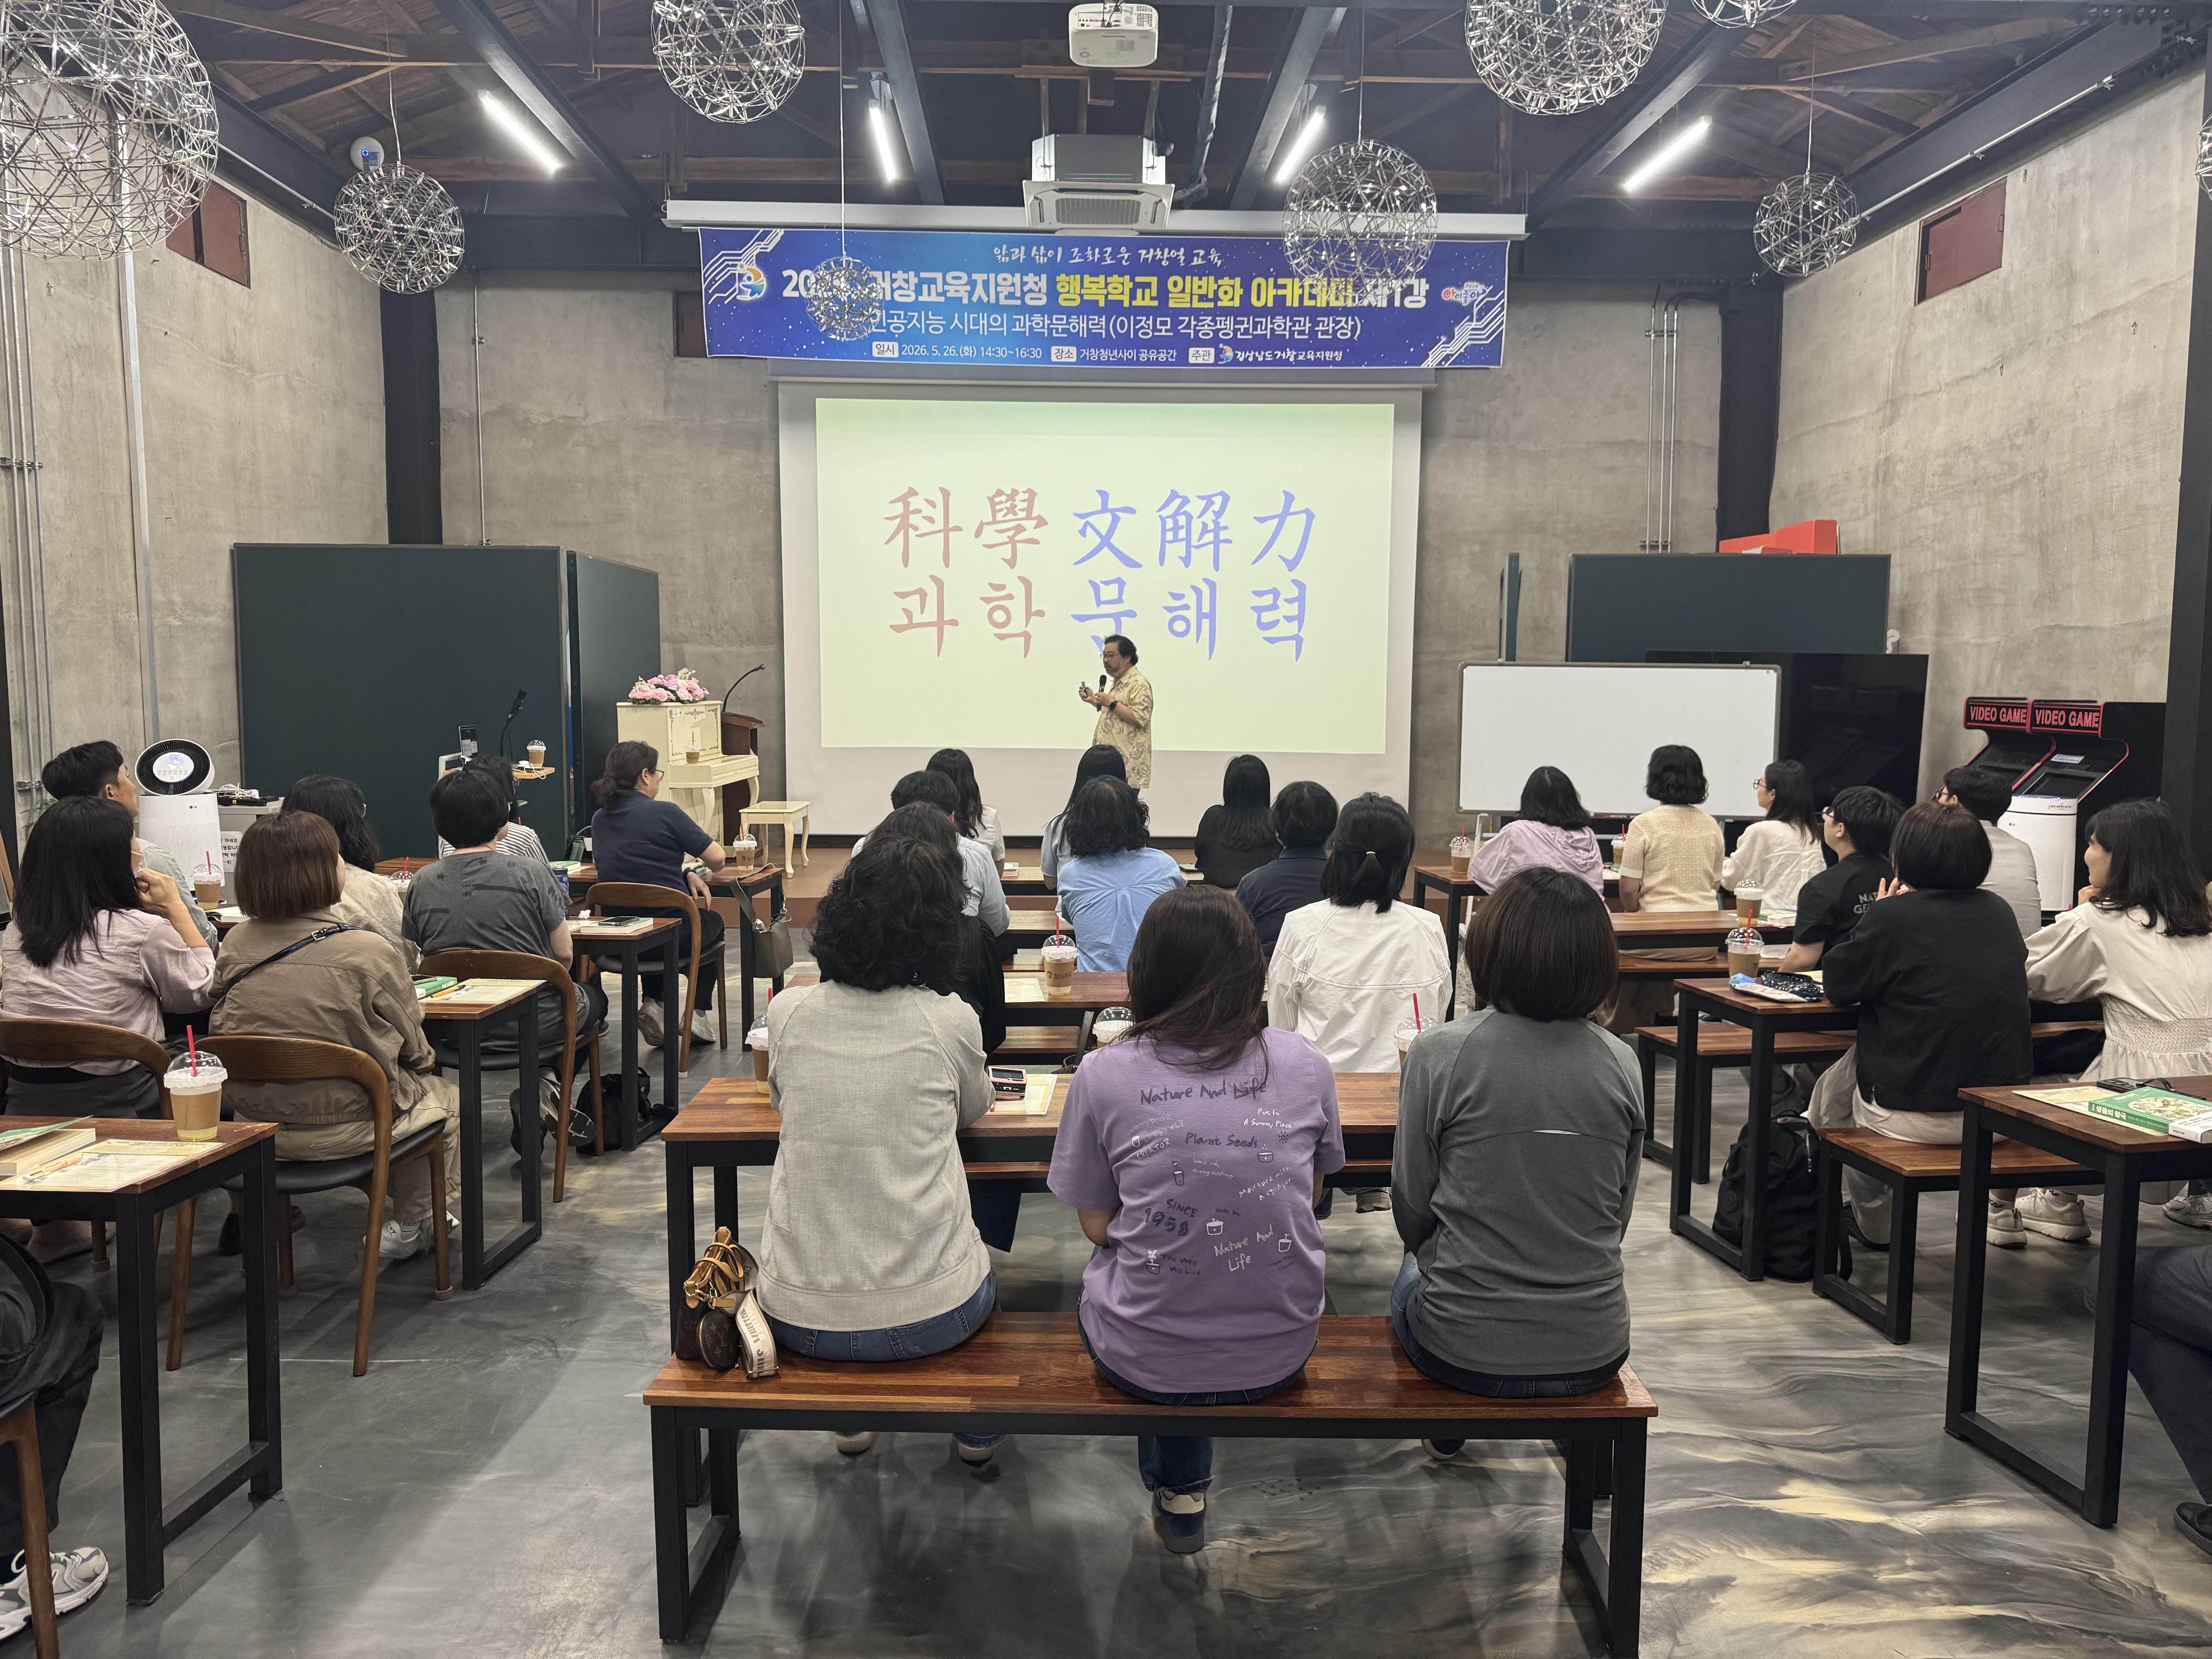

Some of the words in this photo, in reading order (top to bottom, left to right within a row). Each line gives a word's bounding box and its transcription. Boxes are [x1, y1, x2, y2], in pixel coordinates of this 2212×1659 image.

[993, 244, 1026, 263] 앎과
[1031, 246, 1062, 264] 삶이
[1068, 246, 1132, 265] 조화로운
[1190, 248, 1221, 267] 교육
[1056, 274, 1159, 307] 행복학교
[1167, 275, 1243, 308] 일반화
[1251, 277, 1353, 307] 아카데미
[870, 309, 946, 334] 인공지능
[950, 312, 1007, 336] 시대의
[1178, 315, 1312, 339] 각종펭귄과학관
[1315, 316, 1362, 340] 관장)
[876, 343, 895, 355] 일시
[980, 346, 1042, 359] 14:30~16:30
[1054, 348, 1074, 360] 장소
[1080, 349, 1137, 361] 거창청년사이
[1138, 349, 1177, 362] 공유공간
[1191, 350, 1211, 361] 주관
[1970, 706, 1997, 721] VIDEO
[1999, 708, 2027, 723] GAME
[2035, 709, 2066, 726] VIDEO
[2068, 711, 2100, 728] GAME
[1140, 1086, 1193, 1105] Nature
[1200, 1078, 1226, 1099] And
[1233, 1077, 1267, 1099] Life
[1251, 1118, 1273, 1129] Sunny
[1276, 1120, 1292, 1128] Place
[1137, 1138, 1171, 1159] CREATOR
[1185, 1131, 1222, 1146] Plant
[1226, 1133, 1258, 1148] Seeds
[1166, 1198, 1198, 1217] SINCE
[385, 1222, 397, 1235] EA7
[1145, 1207, 1189, 1236] 1958
[1214, 1237, 1249, 1257] Nature
[1256, 1223, 1274, 1242] And
[1228, 1253, 1252, 1272] Life
